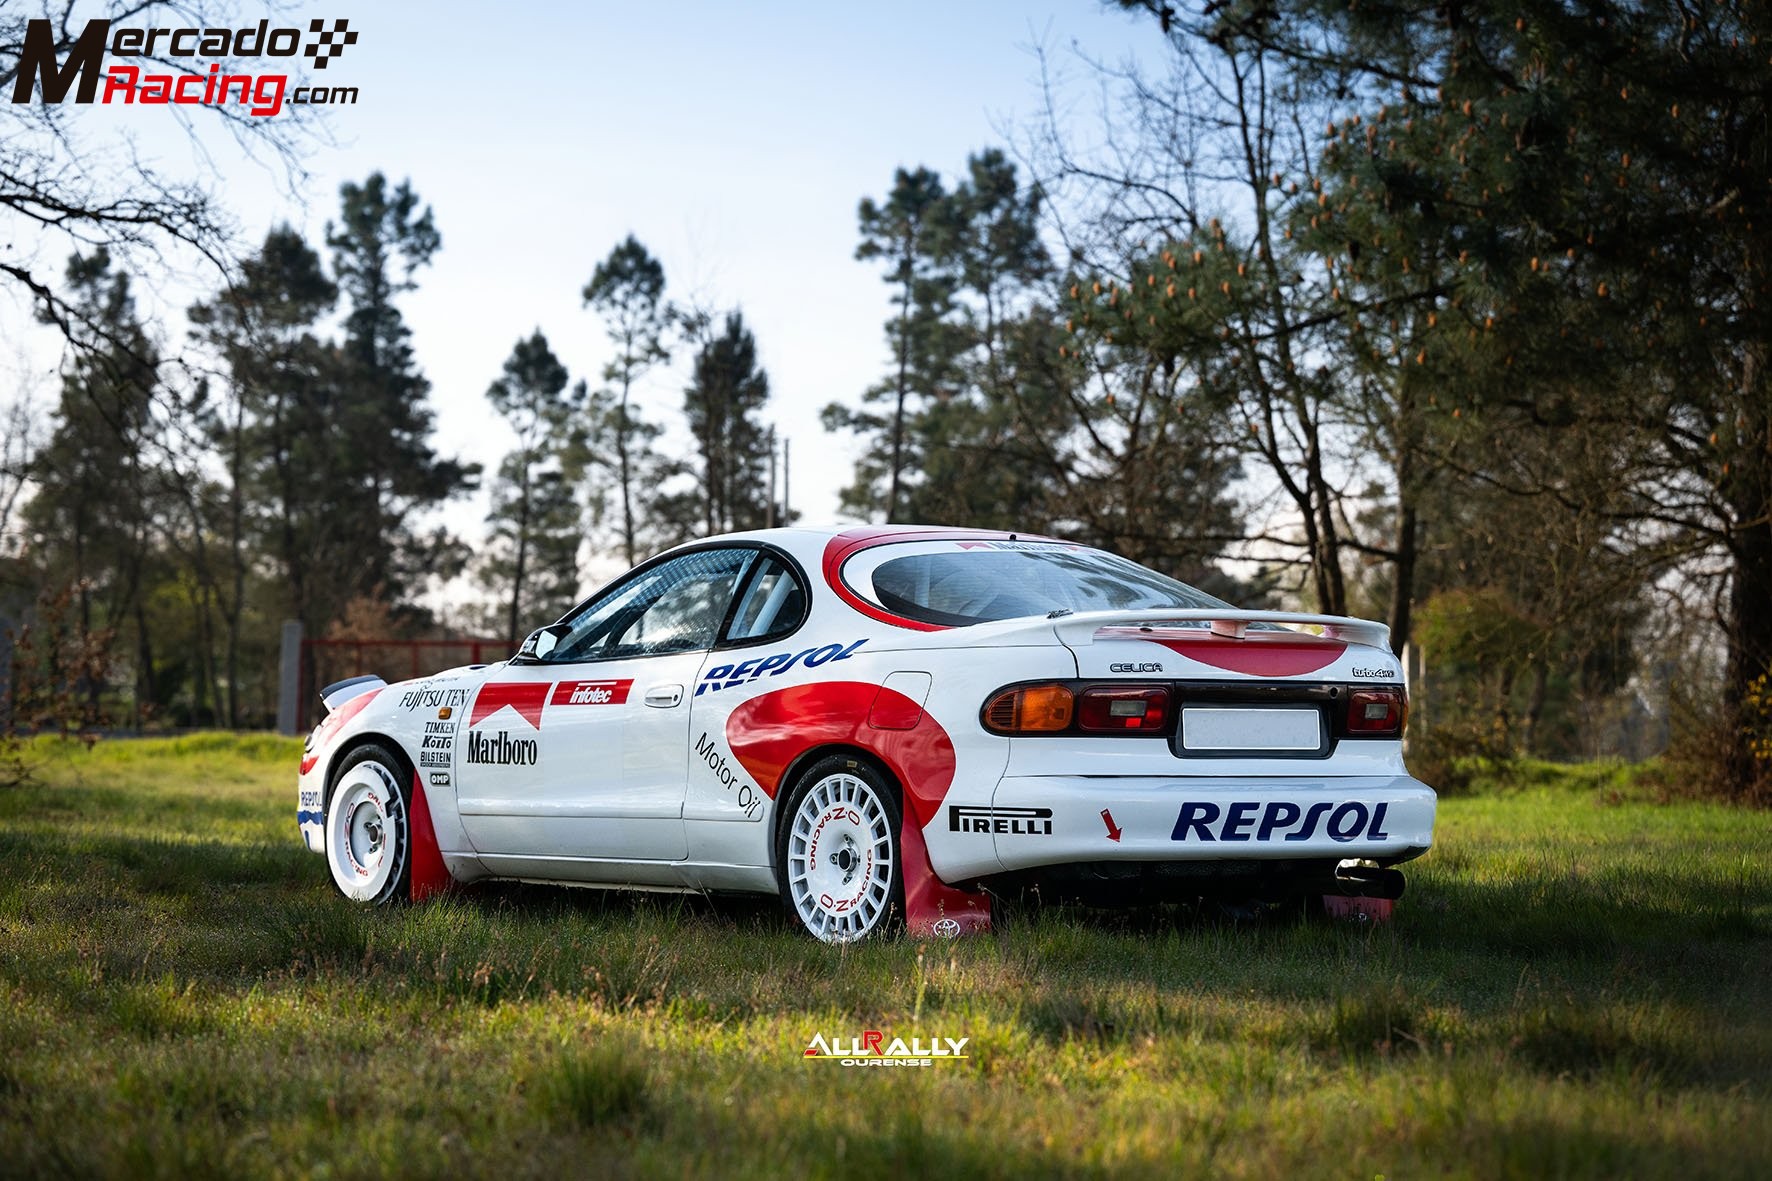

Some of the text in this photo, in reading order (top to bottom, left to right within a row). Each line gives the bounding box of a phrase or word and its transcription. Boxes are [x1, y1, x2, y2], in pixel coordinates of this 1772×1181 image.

[694, 638, 870, 697] REPSOL
[1110, 662, 1163, 673] CELICA
[399, 688, 470, 712] FUJITSU TEN
[569, 687, 613, 704] infotec
[425, 722, 456, 734] TIMKEN
[420, 751, 451, 762] BILSTEIN
[467, 731, 538, 765] Marlboro
[431, 774, 449, 784] OMP
[695, 732, 761, 818] Motor Oil
[949, 805, 1053, 835] PIRELLI
[1170, 801, 1389, 843] REPSOL
[810, 812, 832, 871] RACING
[850, 849, 872, 908] RACING
